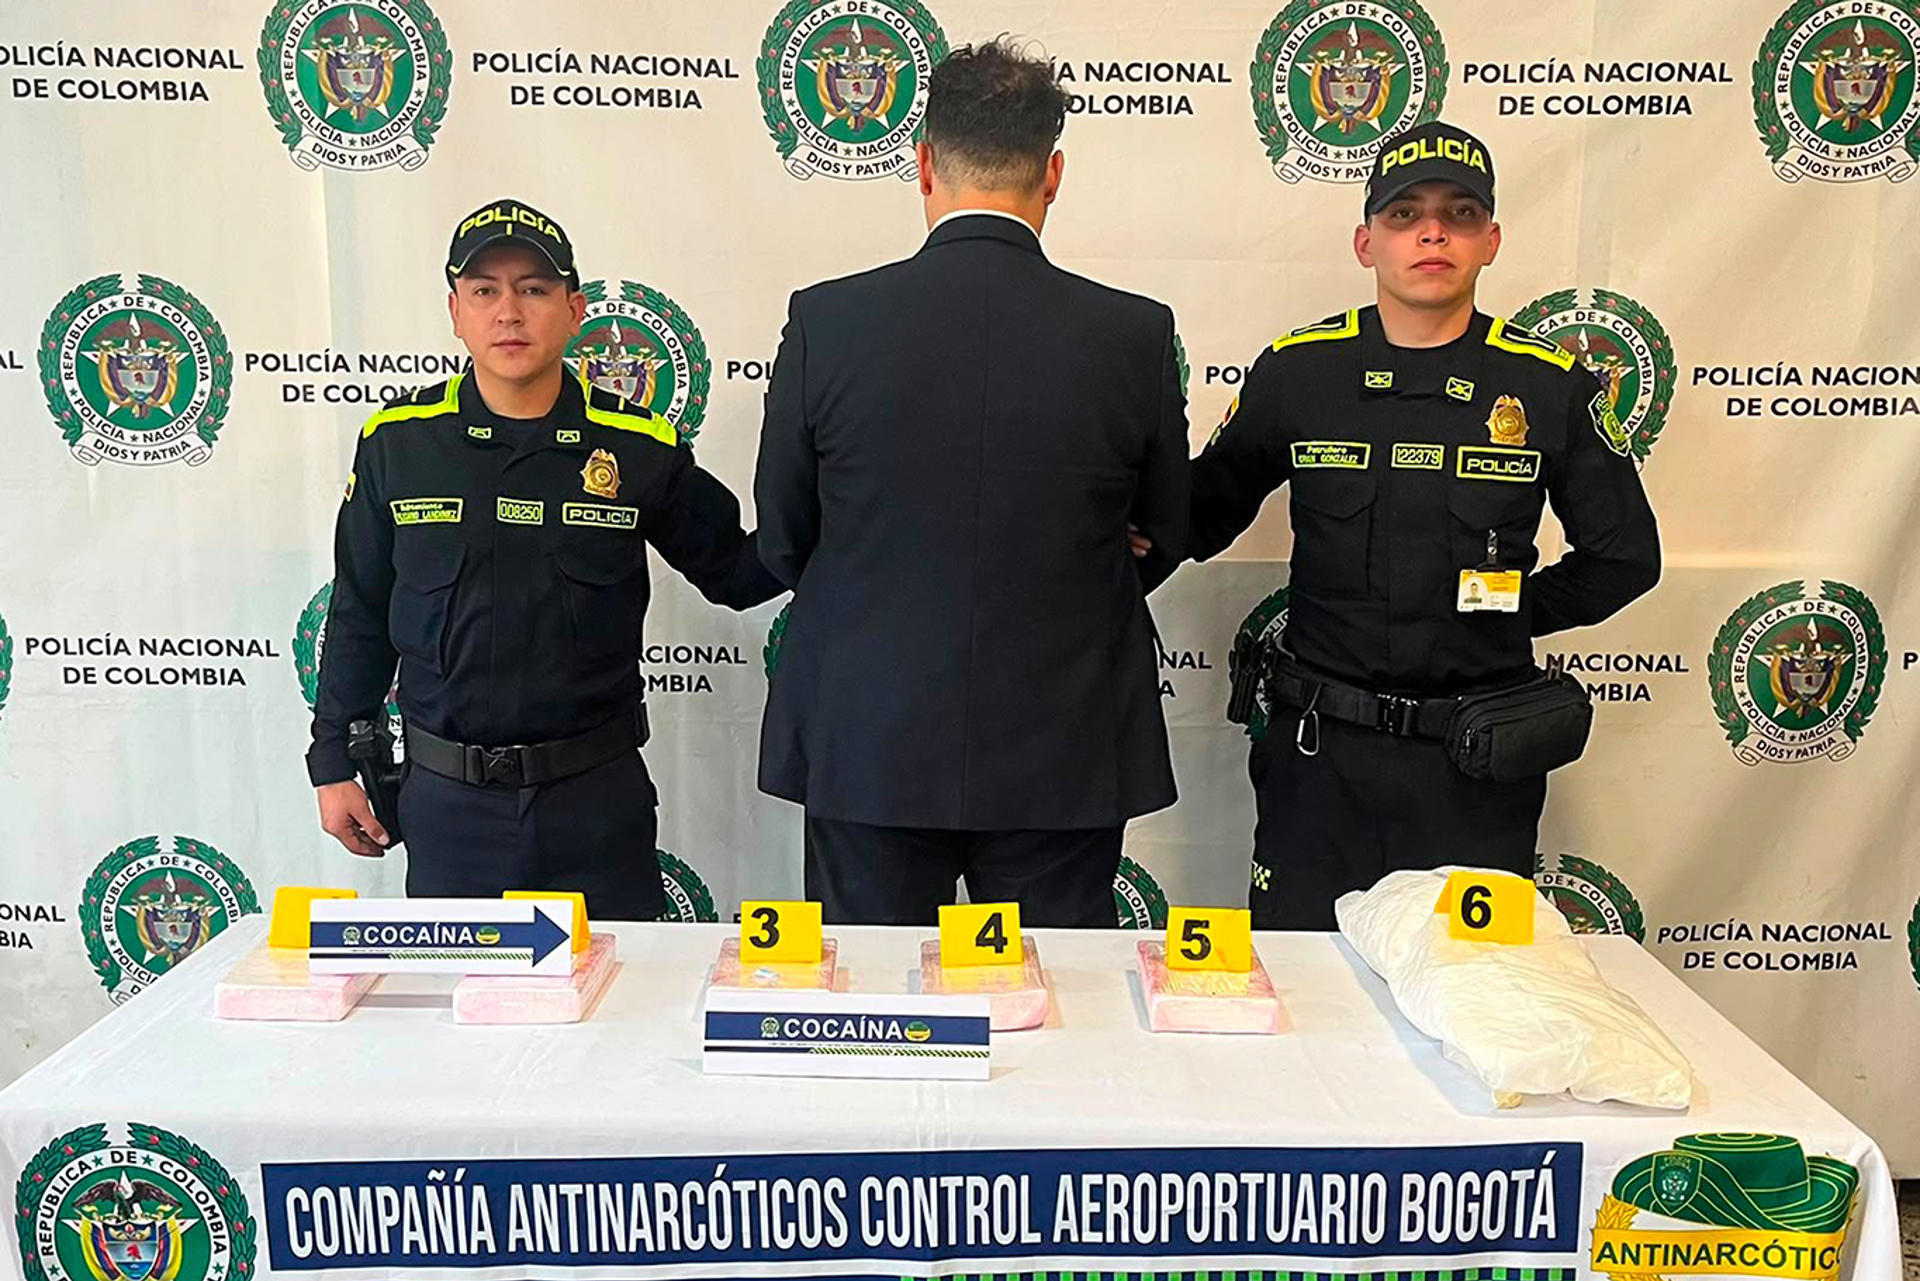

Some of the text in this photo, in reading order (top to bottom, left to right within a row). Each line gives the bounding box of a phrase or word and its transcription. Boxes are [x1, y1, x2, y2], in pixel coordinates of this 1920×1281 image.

[1852, 3, 1872, 13] DE
[378, 0, 427, 81] COLOMBIA
[847, 2, 868, 13] DE
[884, 10, 929, 92] COLOMBIA
[1346, 4, 1367, 15] DE
[1382, 13, 1424, 95] COLOMBIA
[94, 47, 244, 69] NACIONAL
[473, 48, 739, 78] POLICÍA NACIONAL
[1463, 57, 1733, 83] POLICÍA NACIONAL
[1085, 62, 1232, 83] NACIONAL
[12, 78, 209, 101] DE COLOMBIA
[511, 86, 702, 109] DE COLOMBIA
[1066, 95, 1193, 115] OLOMBIA
[1499, 95, 1692, 115] DE COLOMBIA
[360, 98, 422, 147] NACIONAL
[856, 110, 922, 157] NACIONAL
[1847, 111, 1918, 159] NACIONAL
[361, 143, 406, 166] PATRIA
[856, 153, 905, 175] PATRIA
[1382, 137, 1487, 176] POLICÍA
[1844, 155, 1897, 178] PATRIA
[1345, 165, 1371, 179] PAT
[123, 296, 144, 307] DE
[161, 305, 209, 382] COLOMBIA
[606, 302, 626, 314] DE
[641, 312, 687, 390] COLOMBIA
[245, 349, 474, 374] POLICÍA NACIONA
[1575, 311, 1652, 396] DE COLOMBIA
[1692, 362, 1920, 386] POLICÍA NACION
[282, 384, 315, 403] DE
[1726, 397, 1920, 416] DE COLOMBIA
[143, 399, 205, 443] NACIONAL
[143, 440, 192, 461] PATRIA
[1396, 448, 1440, 465] 122379
[1466, 456, 1533, 474] POLICÍA
[500, 503, 540, 520] 008250
[568, 510, 632, 524] POLICÍA
[25, 633, 280, 657] POLICÍA NACIONAL
[1803, 602, 1825, 612] DE
[1839, 609, 1867, 681] COLOMBIA
[644, 646, 748, 664] CIONAL
[63, 667, 246, 686] DE COLOMBIA
[648, 675, 713, 693] MBIA
[1587, 683, 1652, 702] MBIA
[1799, 696, 1857, 742] NACIONAL
[1795, 736, 1837, 759] PATRIA
[160, 856, 179, 866] DE
[662, 878, 695, 922] OLOMB
[1117, 881, 1150, 929] OLOMB
[1461, 885, 1492, 929] 6
[1543, 874, 1622, 934] DE COLOM
[0, 903, 66, 922] ONAL
[363, 922, 472, 945] COCAÍNA
[749, 907, 779, 949] 3
[975, 912, 1008, 953] 4
[1180, 919, 1211, 961] 5
[1658, 918, 1892, 944] POLICÍA NACIONAL
[1683, 952, 1858, 970] DE COLOMBIA
[783, 1016, 903, 1040] COCAÍNA
[110, 1150, 137, 1165] DE
[159, 1161, 227, 1254] COLOMBIA
[286, 1150, 1557, 1258] COMPAÑÍA ANTINARCÓTICOS CONTROL AEROPORTUARIO BOGOTÁ
[1595, 1239, 1840, 1271] ANTINARCÓTIC
